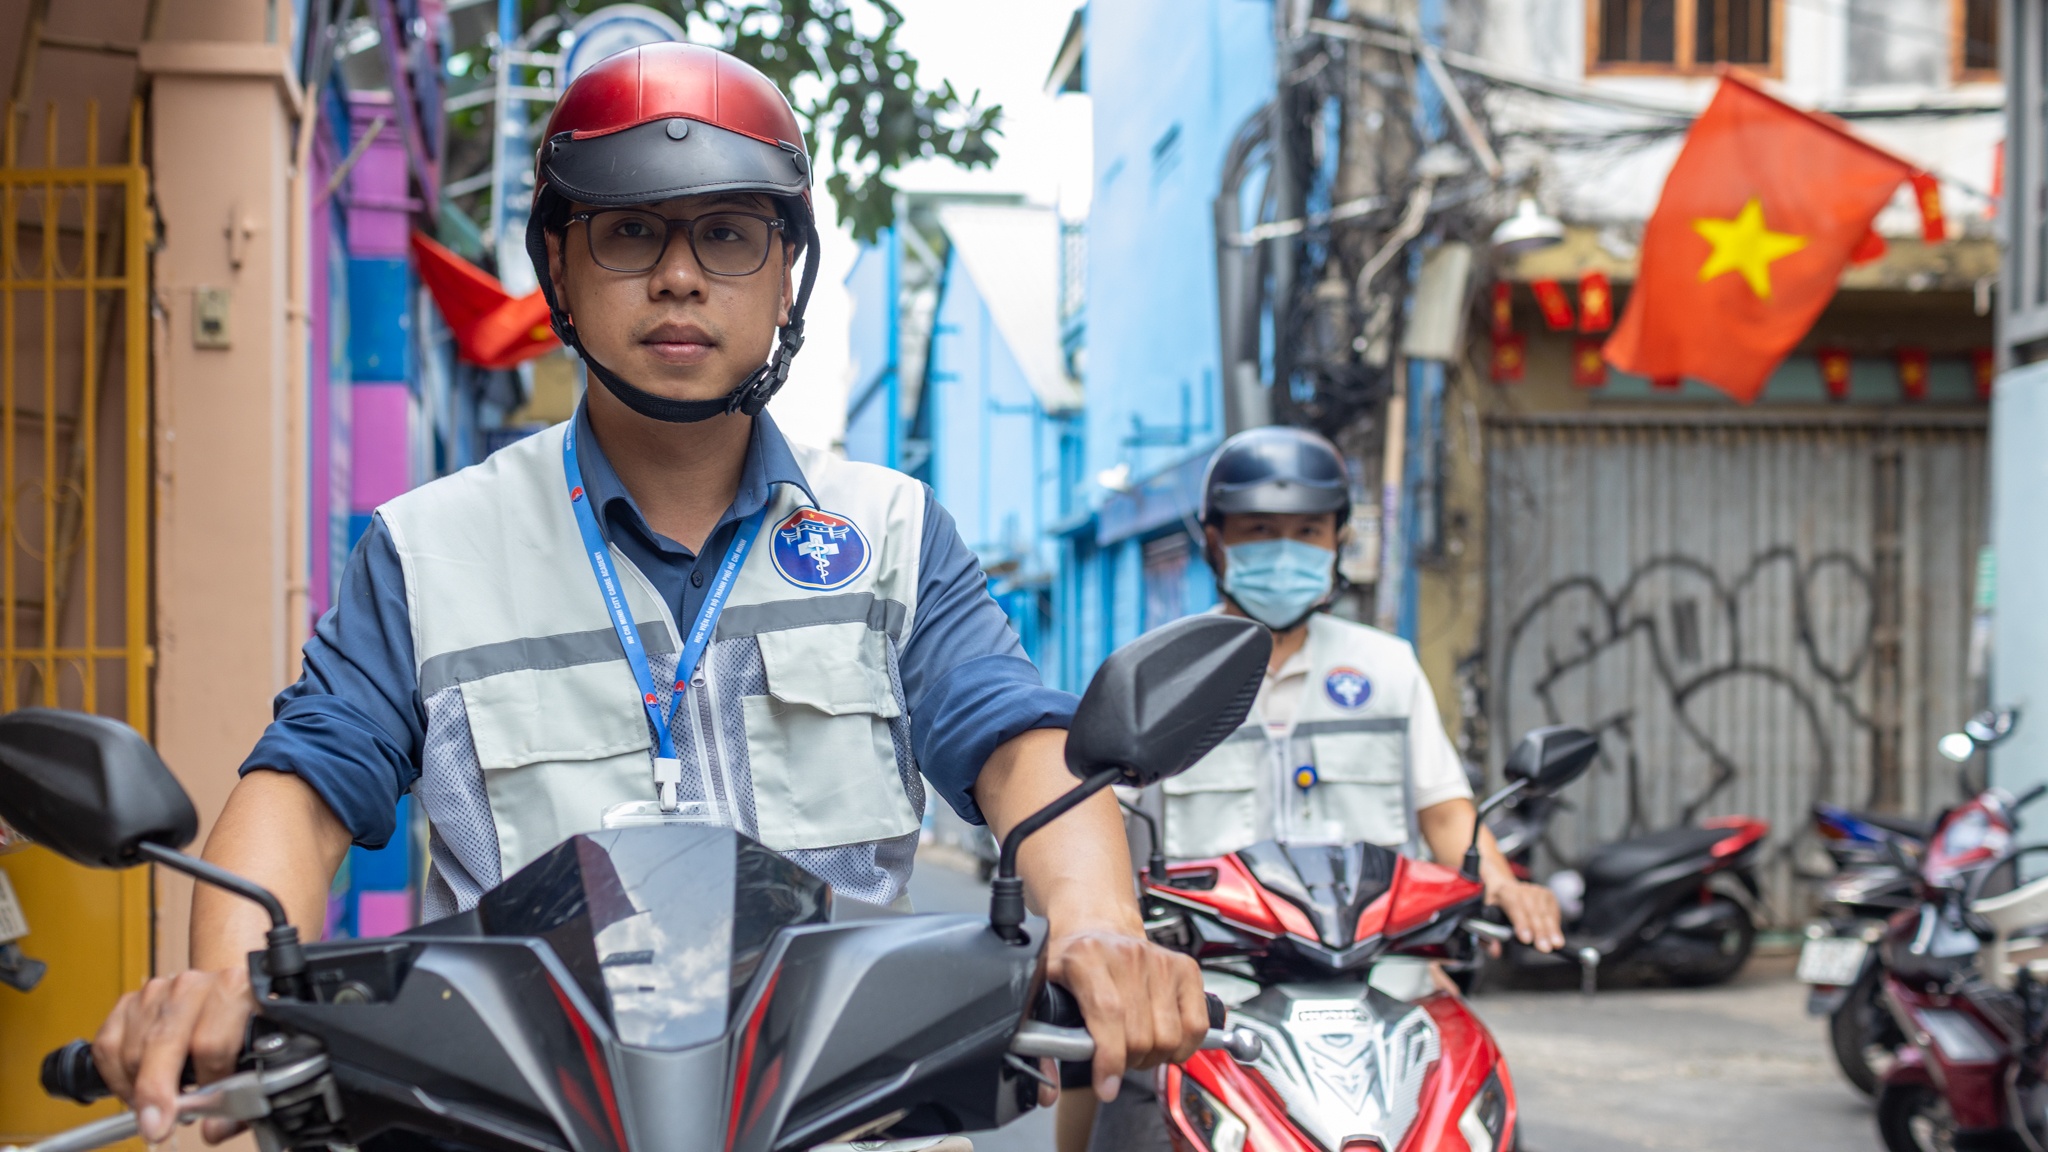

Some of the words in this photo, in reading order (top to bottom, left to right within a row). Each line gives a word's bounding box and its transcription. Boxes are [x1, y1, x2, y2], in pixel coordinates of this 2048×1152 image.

[594, 551, 609, 577] ACADEMY
[603, 577, 616, 596] CADRE
[610, 596, 621, 609] CITY
[615, 609, 628, 625] MINH
[622, 625, 631, 636] CHI
